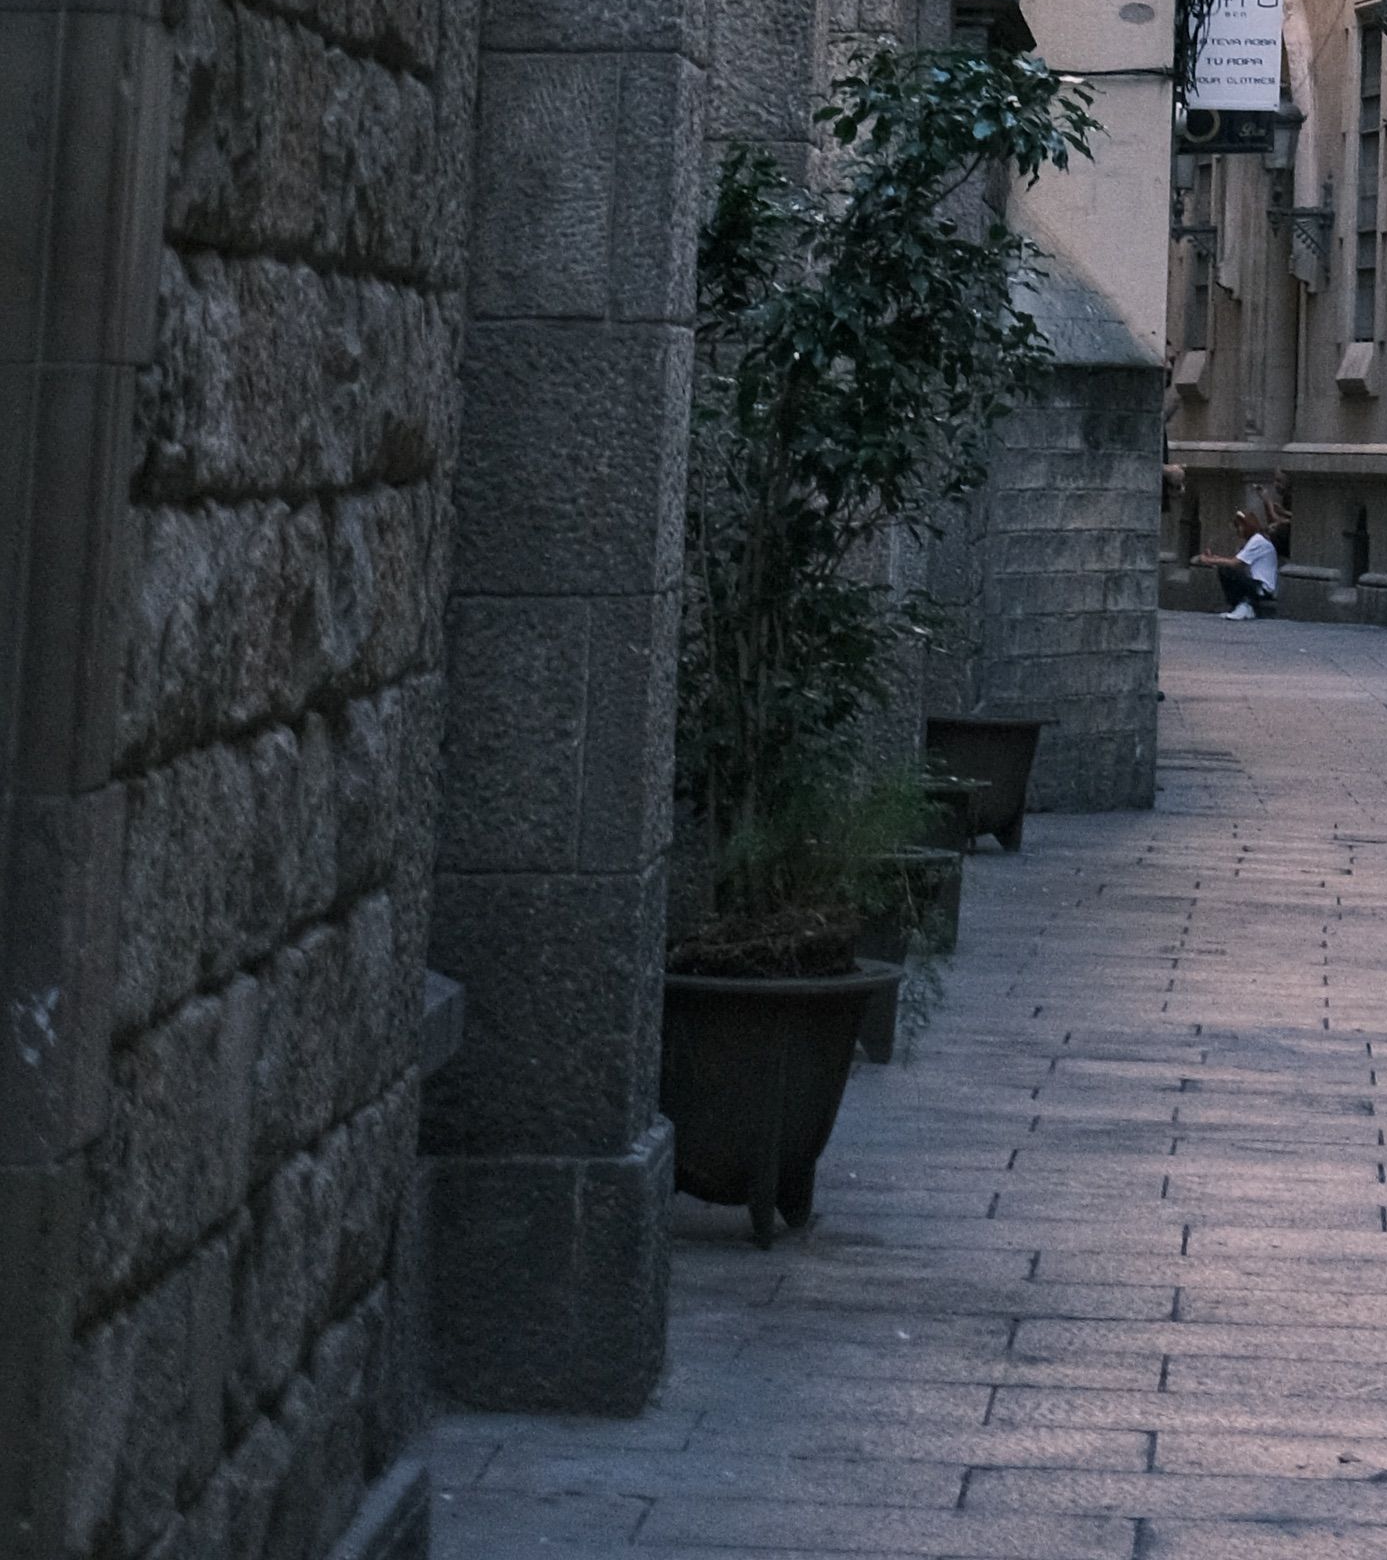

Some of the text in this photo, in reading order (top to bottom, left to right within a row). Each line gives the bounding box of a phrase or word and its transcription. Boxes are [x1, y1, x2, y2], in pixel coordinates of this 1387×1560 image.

[1206, 56, 1263, 66] TU ROPA
[1226, 76, 1276, 86] CLOTHES
